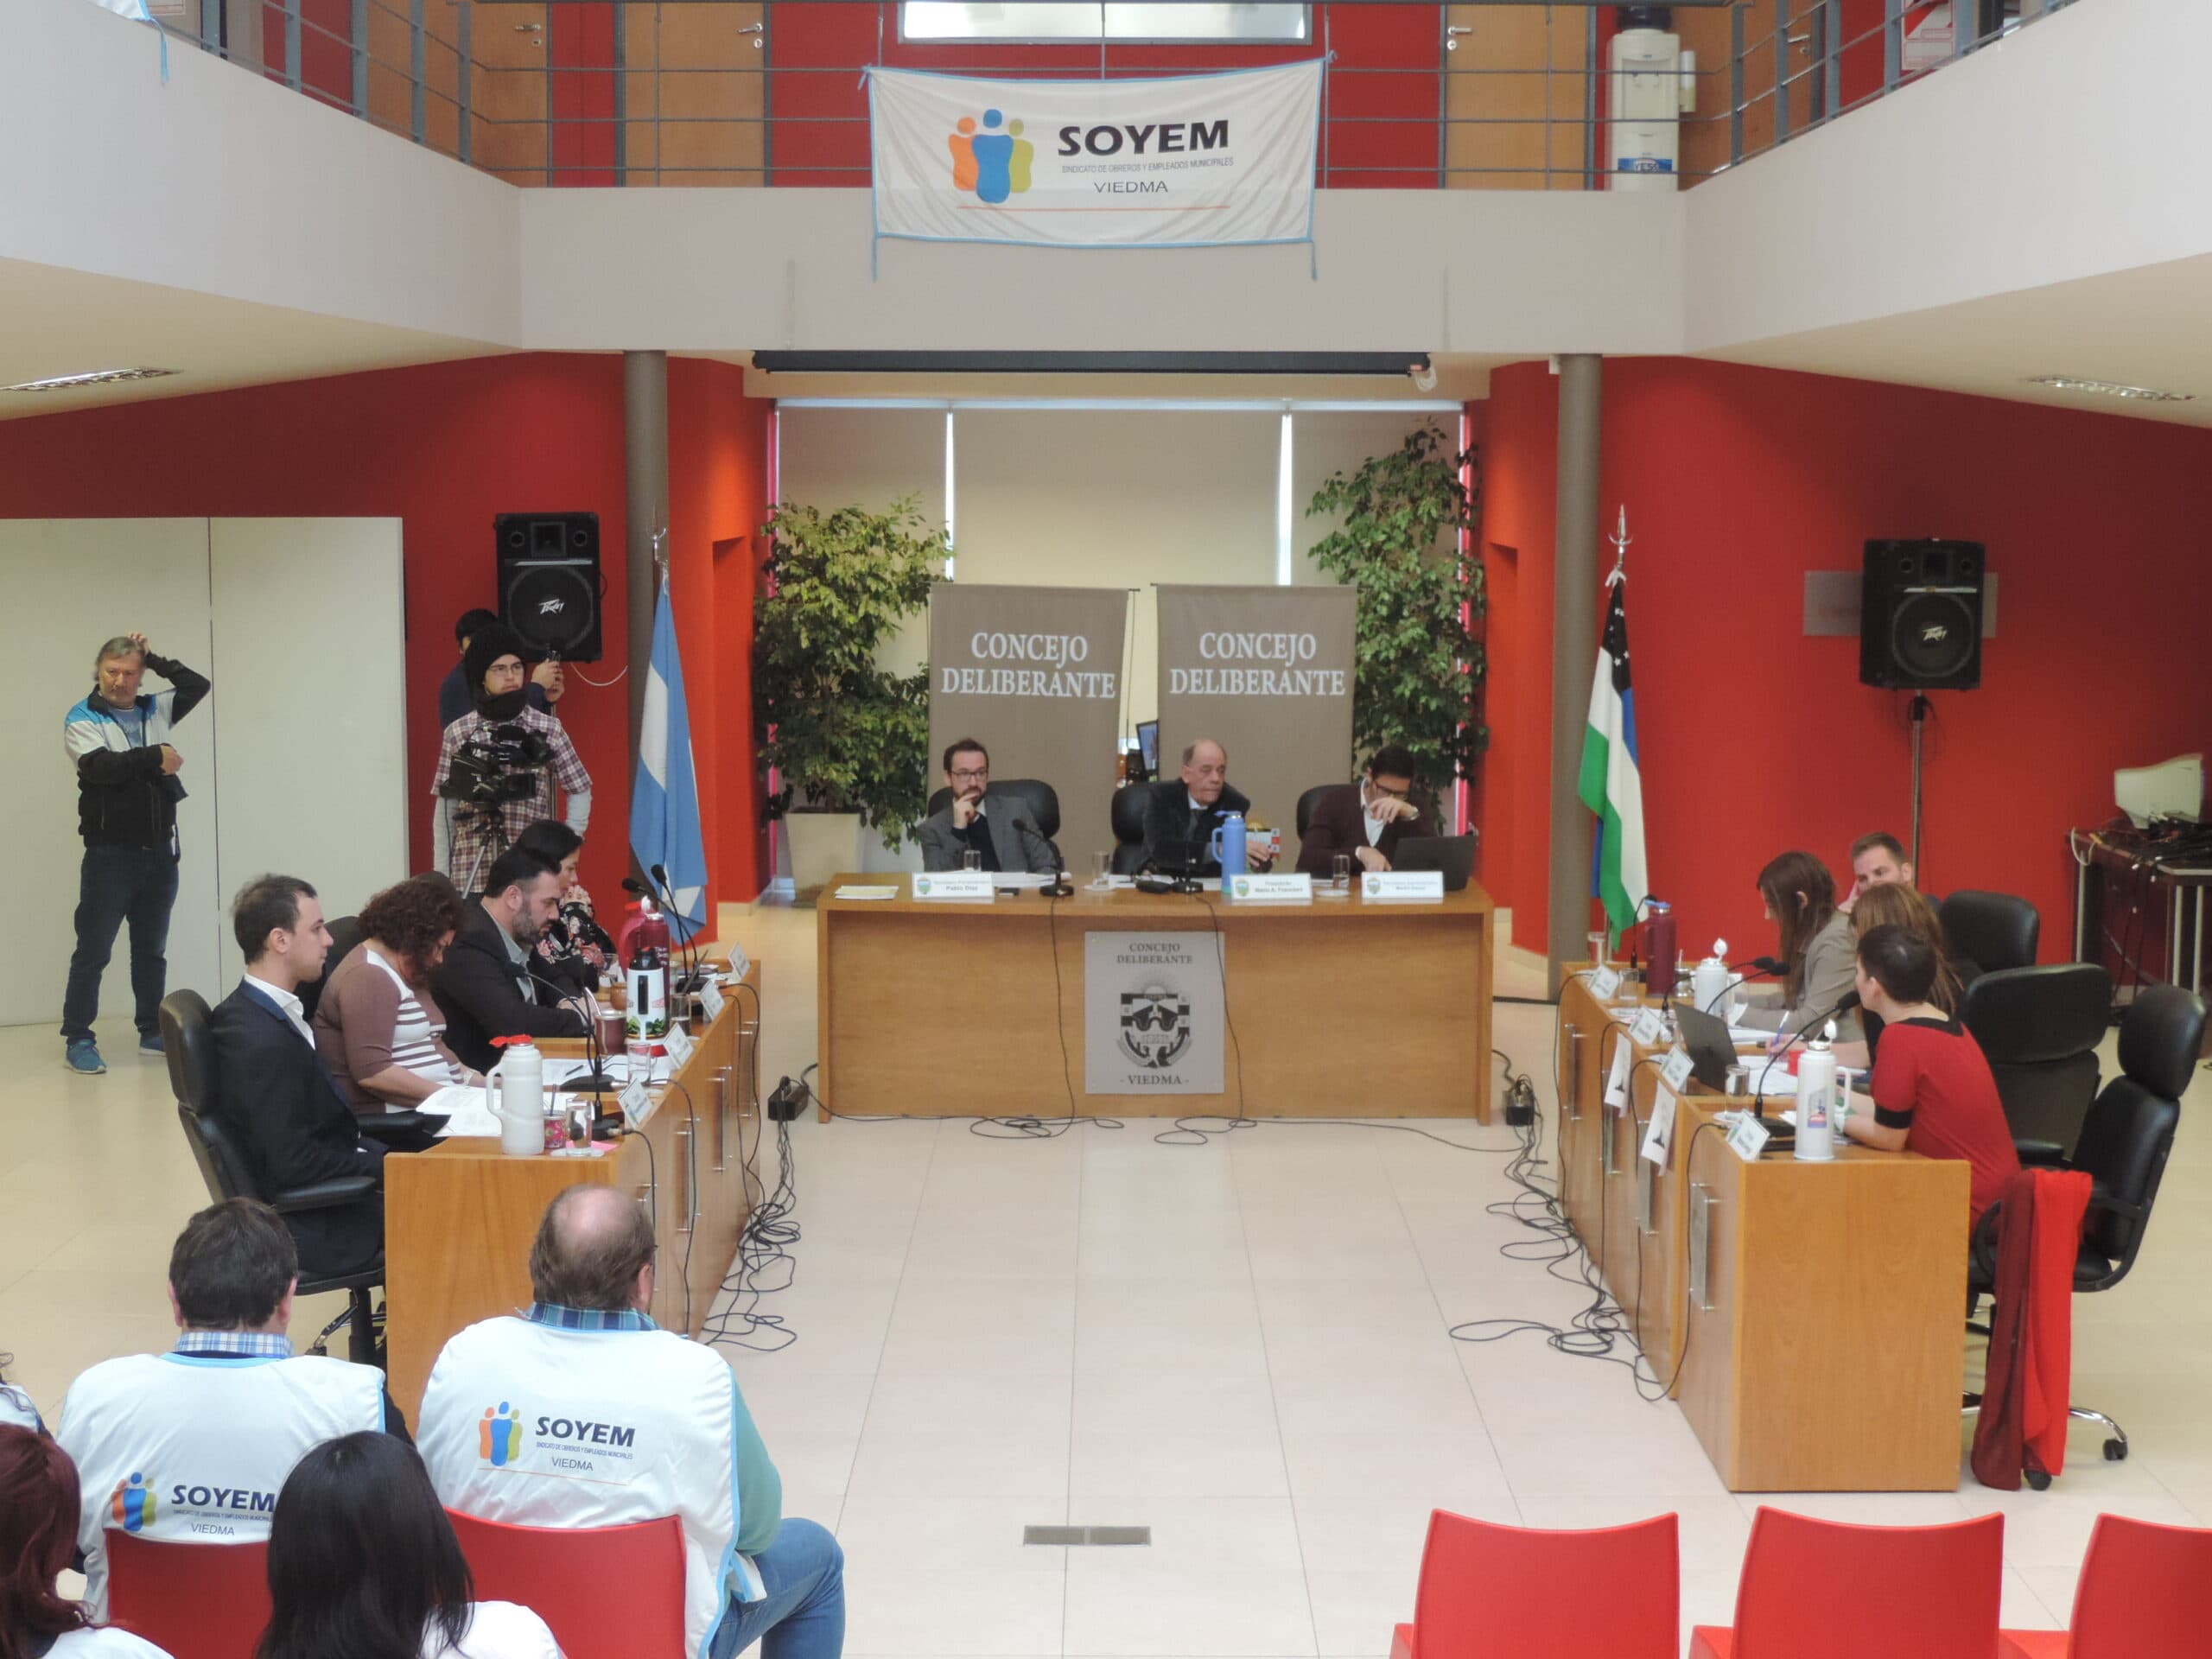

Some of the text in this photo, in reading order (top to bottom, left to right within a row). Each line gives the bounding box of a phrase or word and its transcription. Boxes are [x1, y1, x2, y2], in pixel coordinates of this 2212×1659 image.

[1058, 119, 1229, 156] SOYEM
[1062, 165, 1097, 174] SINDICATO
[1109, 164, 1141, 173] OBREROS
[1147, 161, 1190, 171] EMPLEADOS
[1190, 157, 1235, 168] MUNICIPALES
[1094, 181, 1168, 194] VIEDMA
[971, 632, 1088, 669] CONCEJO
[1199, 632, 1317, 667] CONCEJO
[941, 667, 1116, 699] DELIBERANTE
[1170, 668, 1346, 696] DELIBERANTE
[1116, 954, 1192, 964] DELIBERANTE
[1128, 943, 1180, 954] CONCEJO
[1127, 1074, 1182, 1085] VIEDMA
[536, 1416, 636, 1447] SOYEM
[551, 1456, 594, 1471] VIEDMA
[171, 1484, 276, 1512] SOYEM
[191, 1522, 235, 1535] VIEDMA
